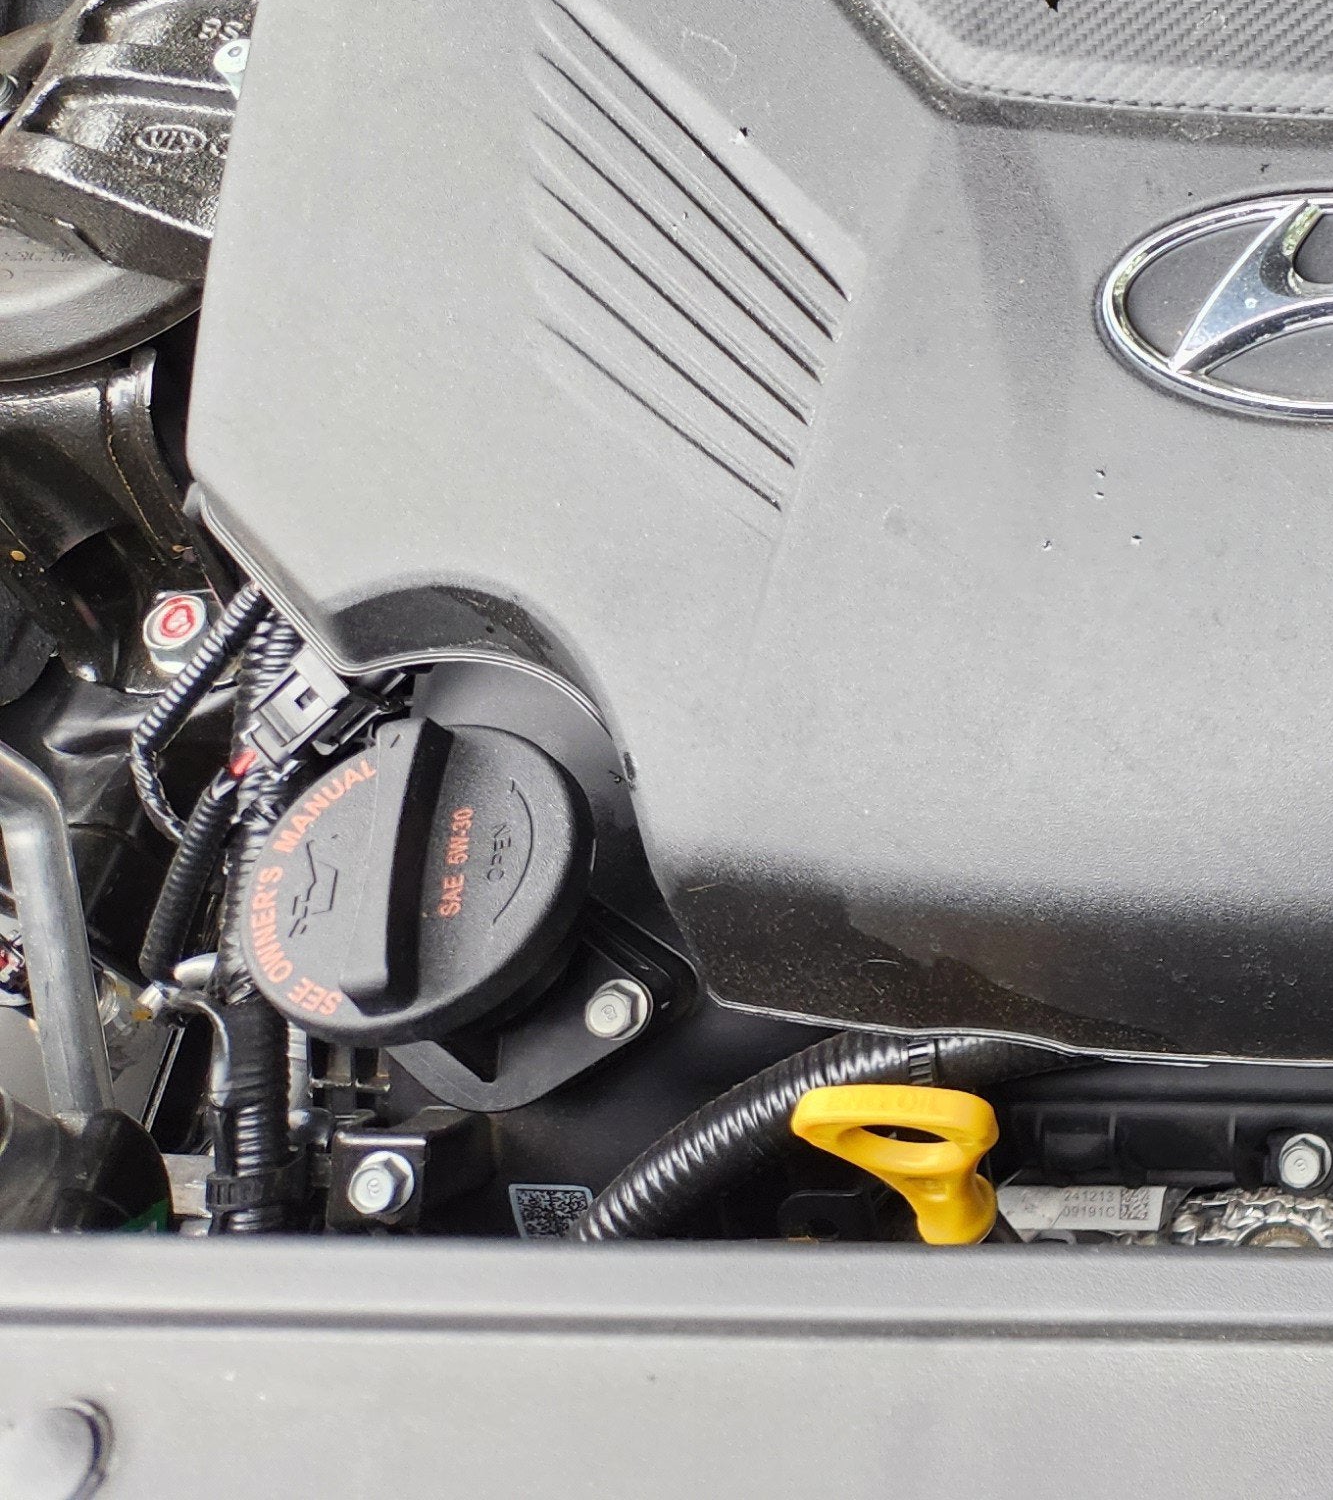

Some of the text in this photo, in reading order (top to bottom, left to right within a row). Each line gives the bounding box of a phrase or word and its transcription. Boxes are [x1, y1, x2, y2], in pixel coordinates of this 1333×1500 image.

[251, 758, 378, 1017] SEE OWNER'S MANUAL
[439, 873, 465, 918] SAE
